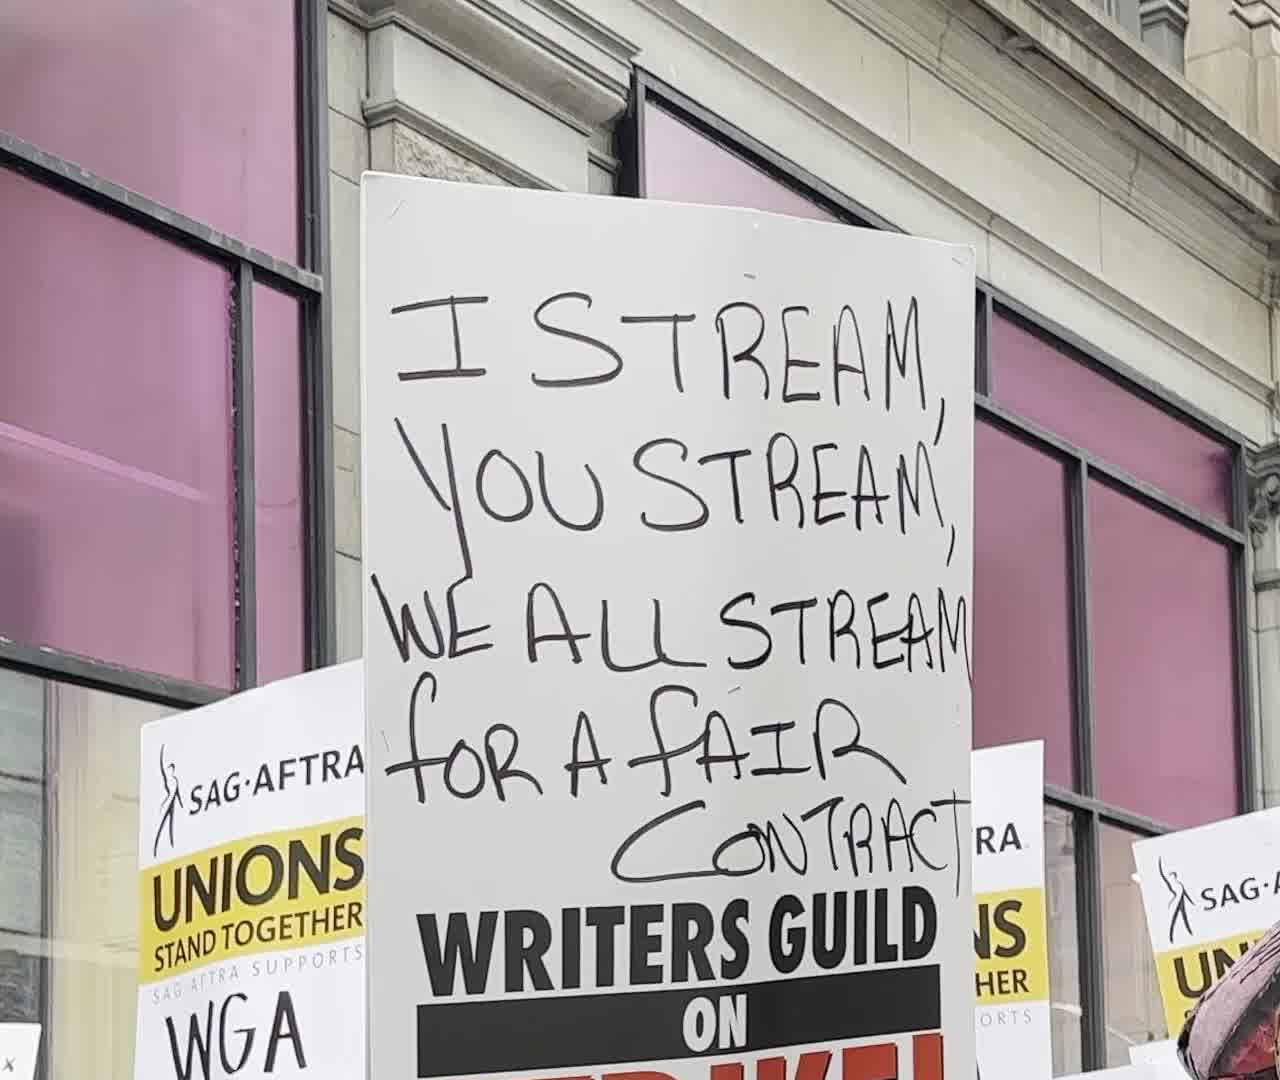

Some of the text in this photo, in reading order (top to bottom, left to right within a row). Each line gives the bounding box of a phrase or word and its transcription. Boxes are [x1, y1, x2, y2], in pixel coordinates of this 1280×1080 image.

[392, 292, 945, 445] I STREAM,
[395, 417, 956, 578] YOU STREAM,
[371, 572, 974, 683] WE ALL STREAM
[565, 712, 612, 798] A
[153, 827, 364, 932] UNIONS
[610, 790, 971, 900] CONTRACT
[154, 901, 364, 973] STAND TOGETHER
[252, 943, 363, 978] SUPPORTS
[416, 895, 750, 998] WRITERS
[769, 886, 938, 975] GUILD
[683, 993, 748, 1053] ON
[980, 1009, 1033, 1028] ORTS
